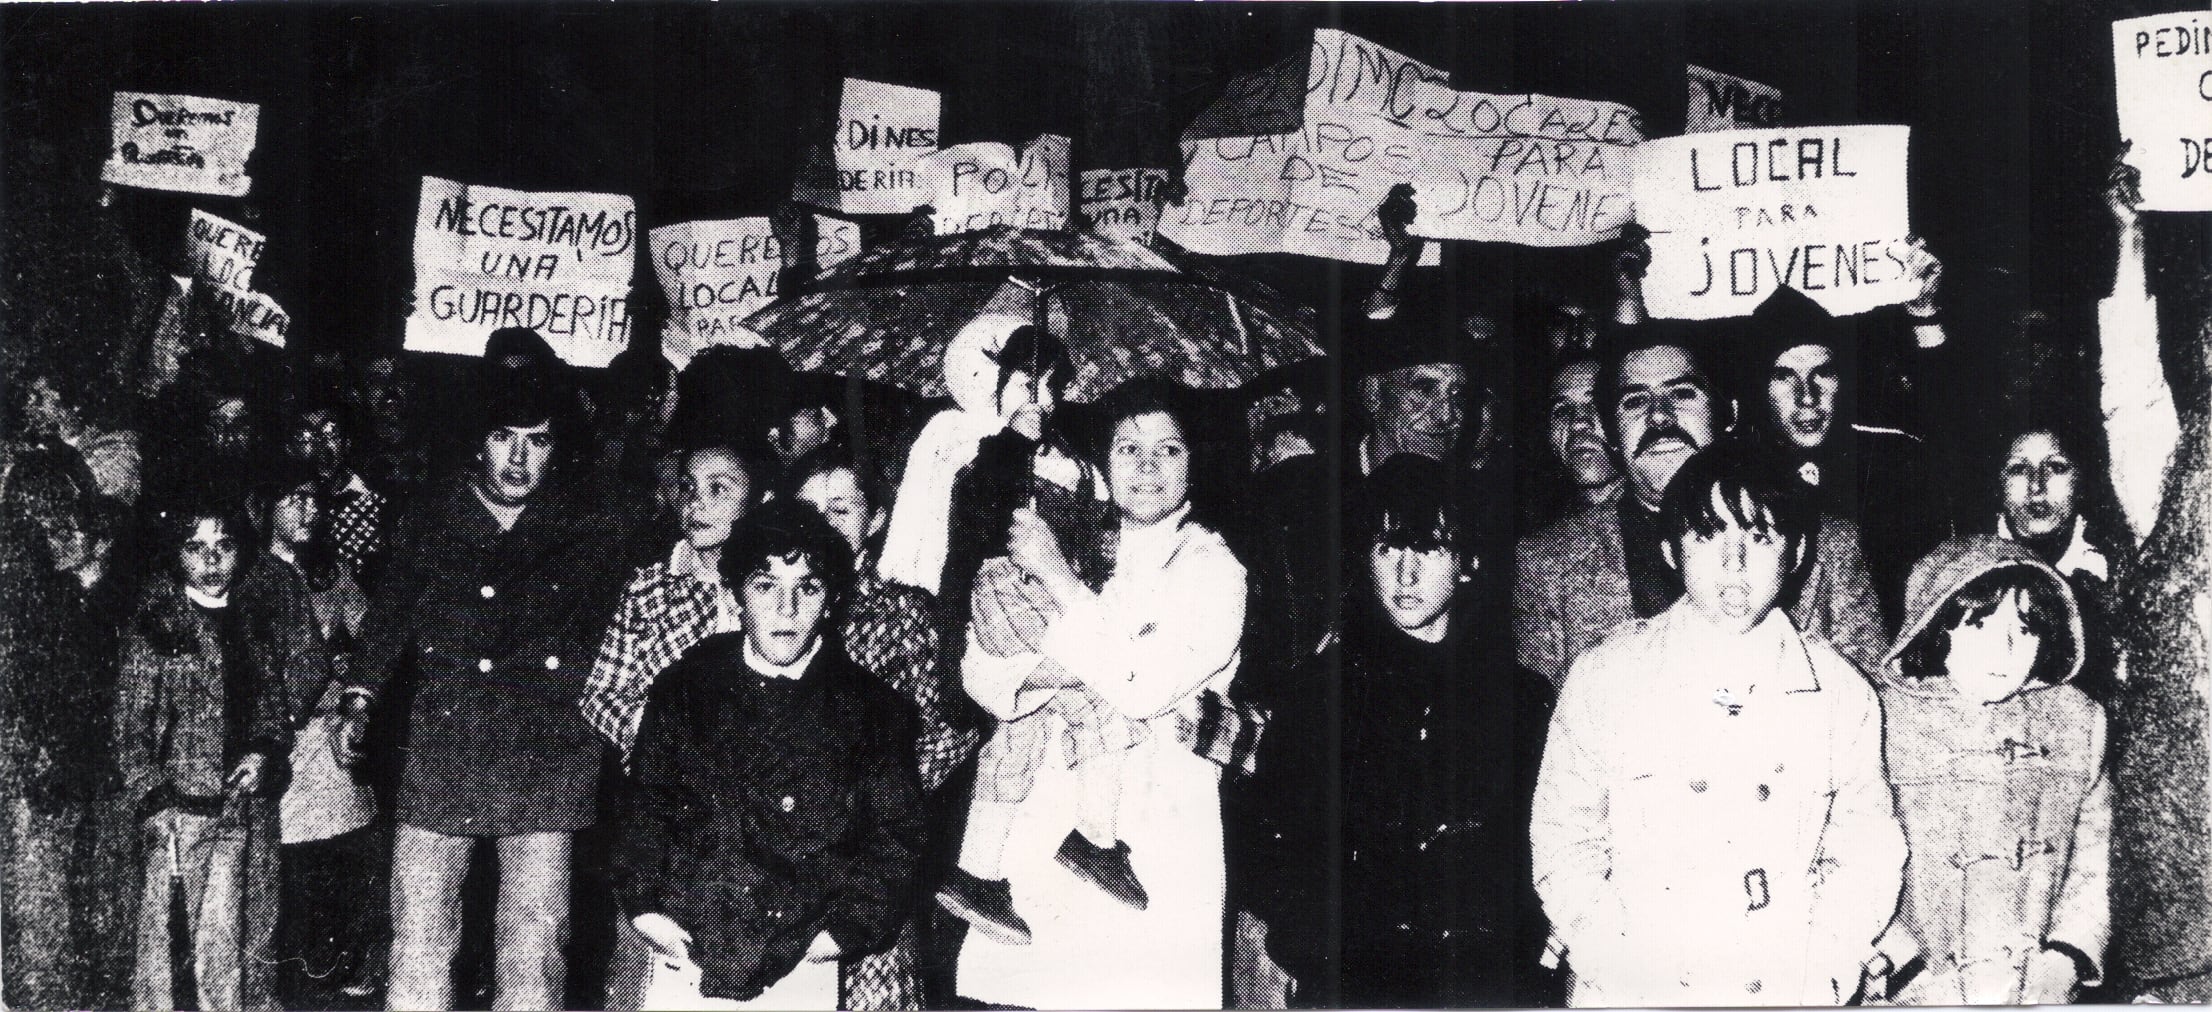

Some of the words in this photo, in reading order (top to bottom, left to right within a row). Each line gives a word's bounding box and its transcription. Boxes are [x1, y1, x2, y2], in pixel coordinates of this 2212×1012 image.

[1280, 155, 1359, 196] DE
[1490, 138, 1609, 179] PARA
[1692, 137, 1857, 190] LOCAL
[434, 196, 636, 261] NECESITAMOS
[1179, 198, 1363, 242] DEPORTES
[1735, 203, 1818, 230] PARA
[480, 250, 559, 283] UNA
